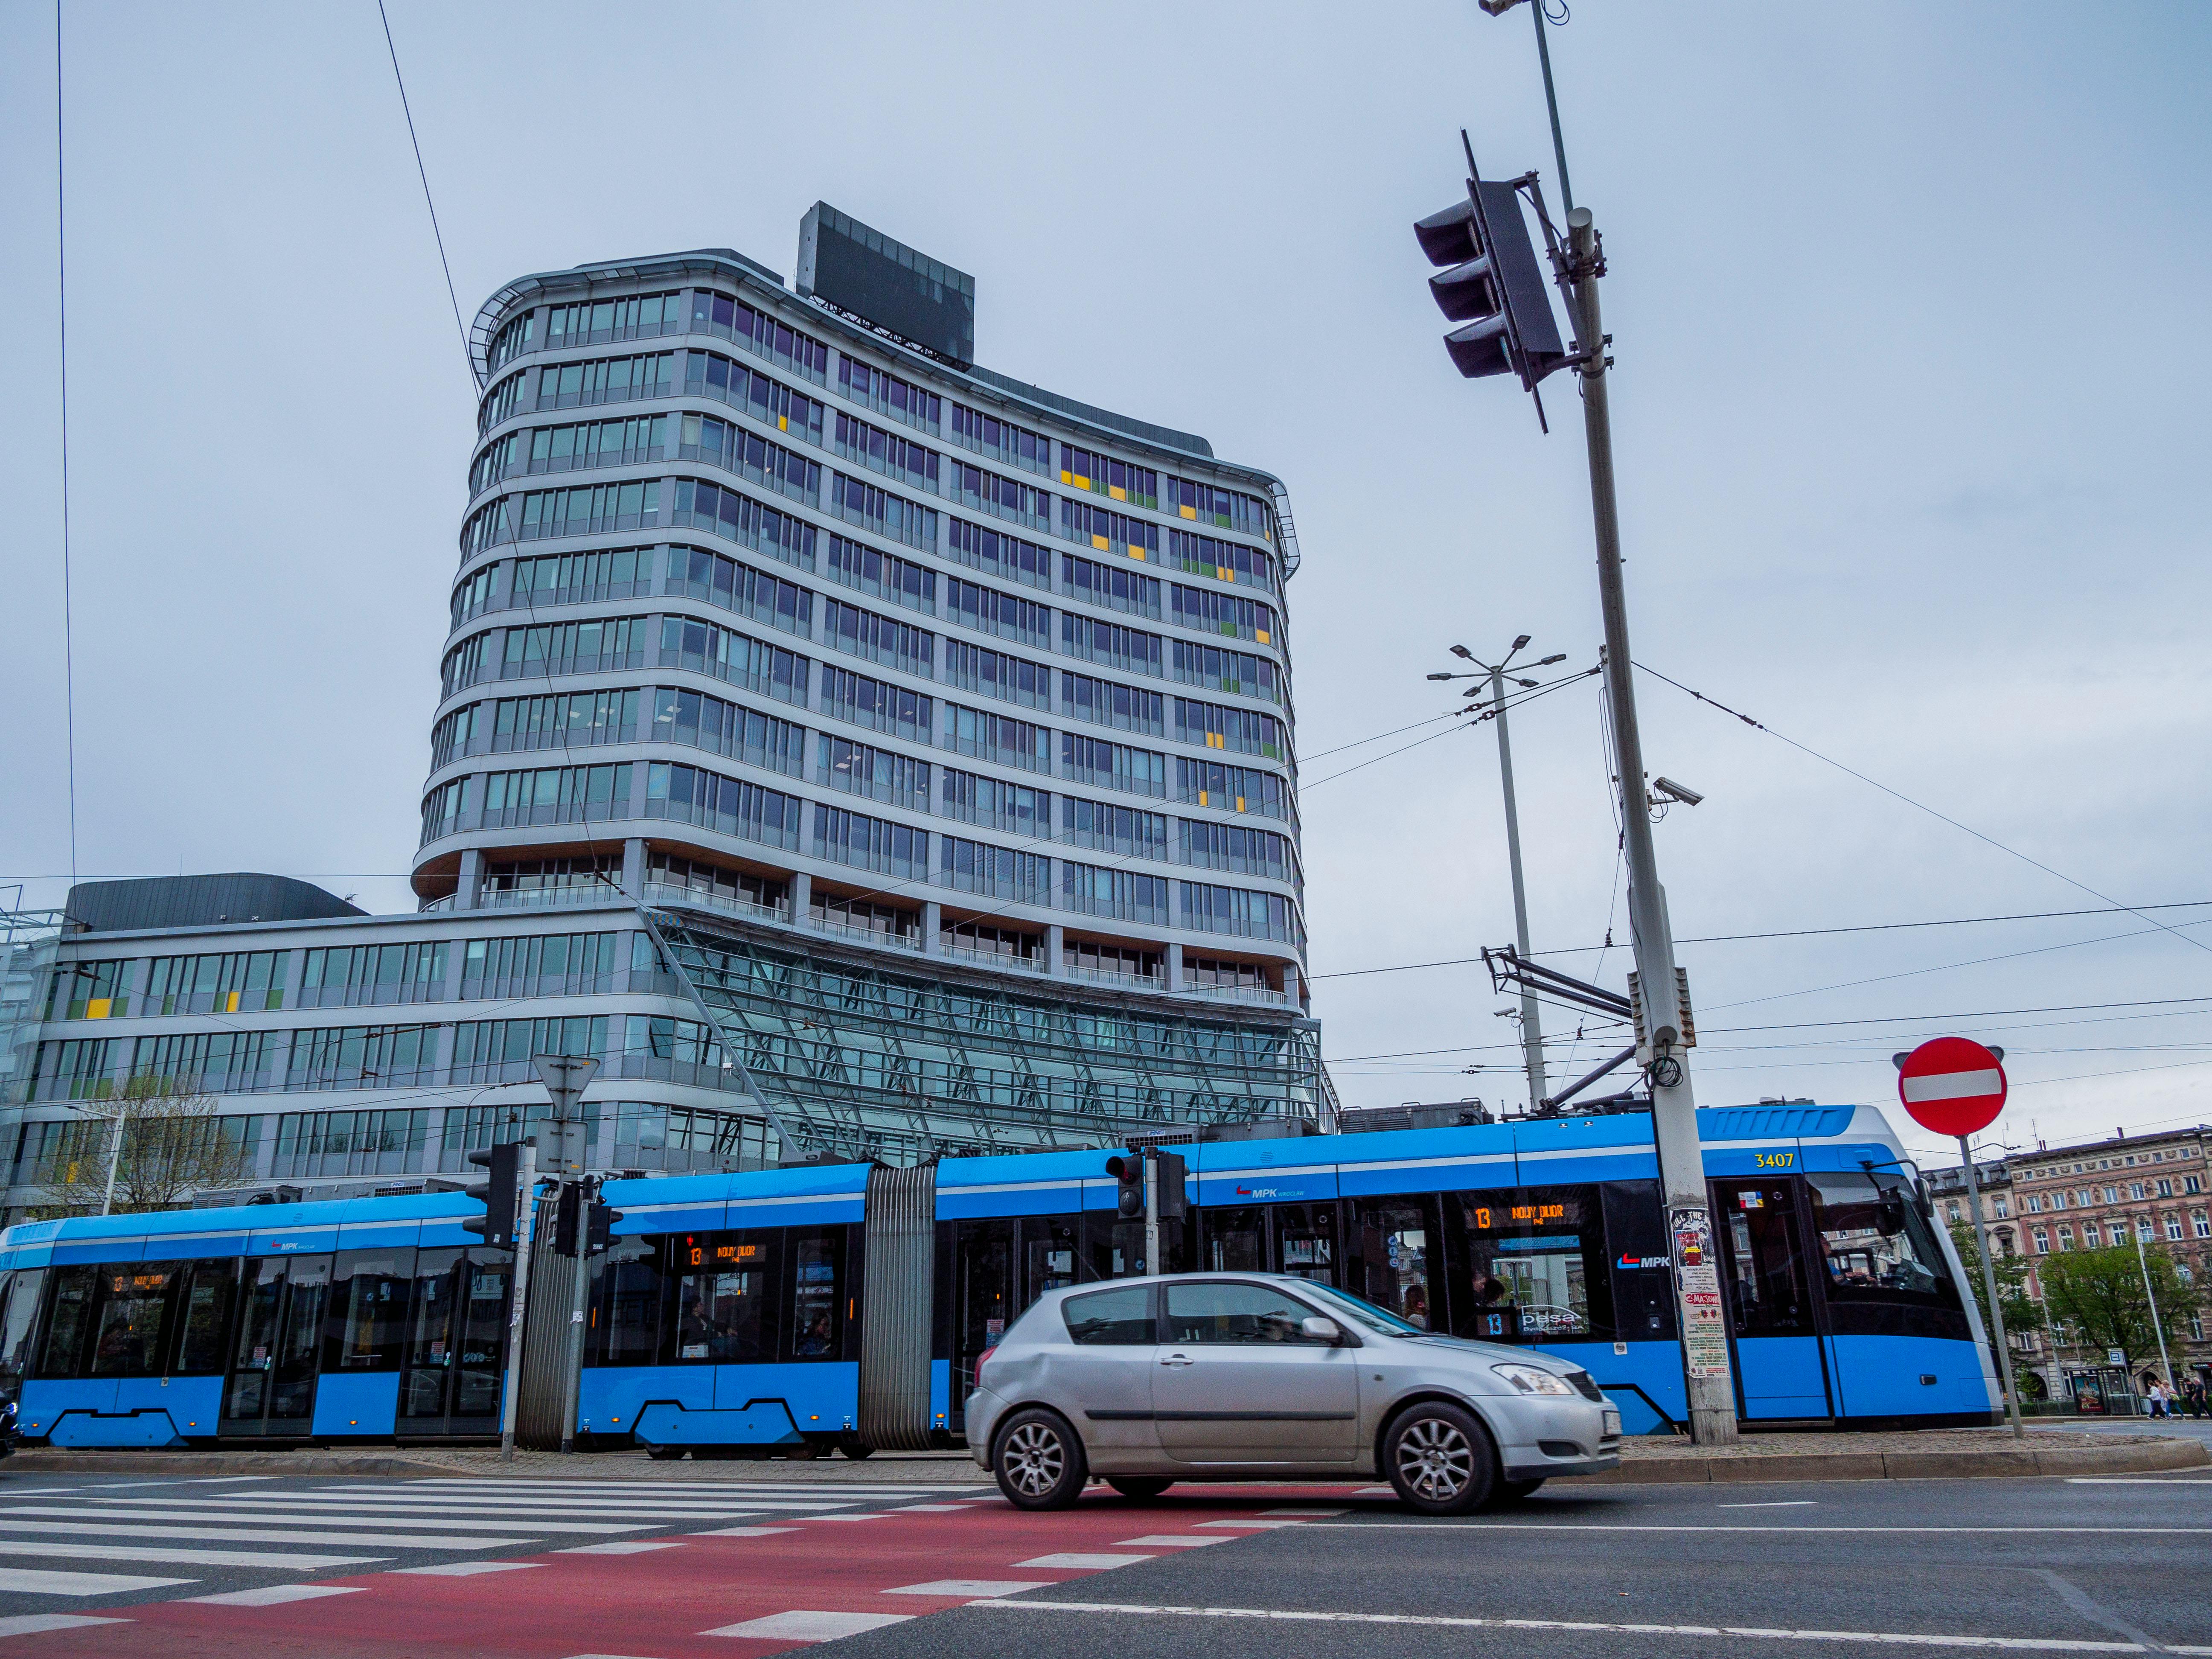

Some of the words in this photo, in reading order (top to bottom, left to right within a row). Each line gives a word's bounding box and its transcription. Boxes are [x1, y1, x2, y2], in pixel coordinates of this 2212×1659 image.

[1755, 1153, 1794, 1167] 3407
[1252, 1188, 1278, 1198] MPK
[1476, 1208, 1490, 1228] 13
[690, 1248, 701, 1265] 13
[1641, 1257, 1670, 1267] MPK
[1487, 1314, 1502, 1335] 13
[1522, 1314, 1576, 1326] pesa
